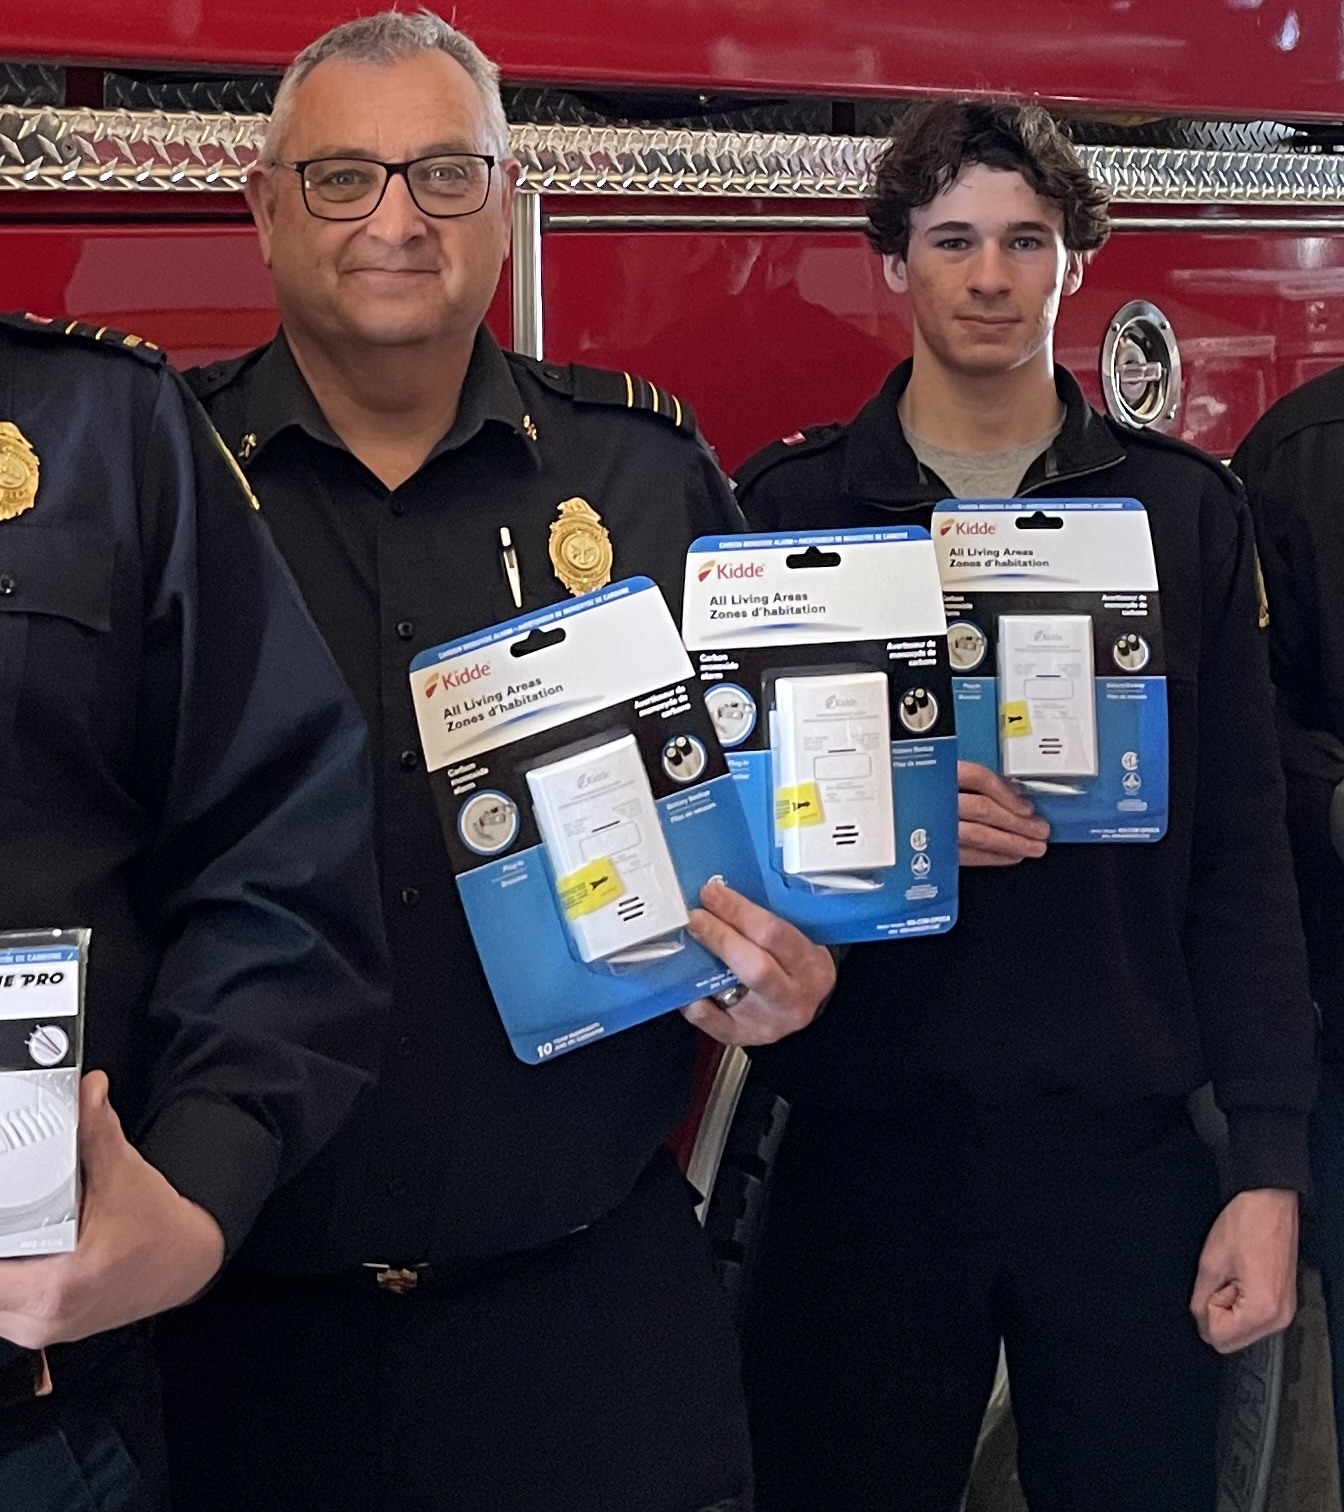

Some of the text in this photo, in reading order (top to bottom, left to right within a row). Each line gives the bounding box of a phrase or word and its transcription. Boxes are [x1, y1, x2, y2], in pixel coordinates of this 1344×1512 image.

[956, 522, 996, 535] Kidde
[950, 548, 1034, 558] All Living Areas
[950, 558, 982, 568] Zones
[717, 562, 765, 580] Kidde
[710, 592, 808, 607] All Living Areas
[710, 608, 748, 620] Zones
[442, 662, 491, 691] Kidde
[443, 677, 543, 720] All Living Areas
[446, 713, 485, 732] Zones
[22, 972, 65, 987] PRO
[537, 1041, 554, 1058] 10
